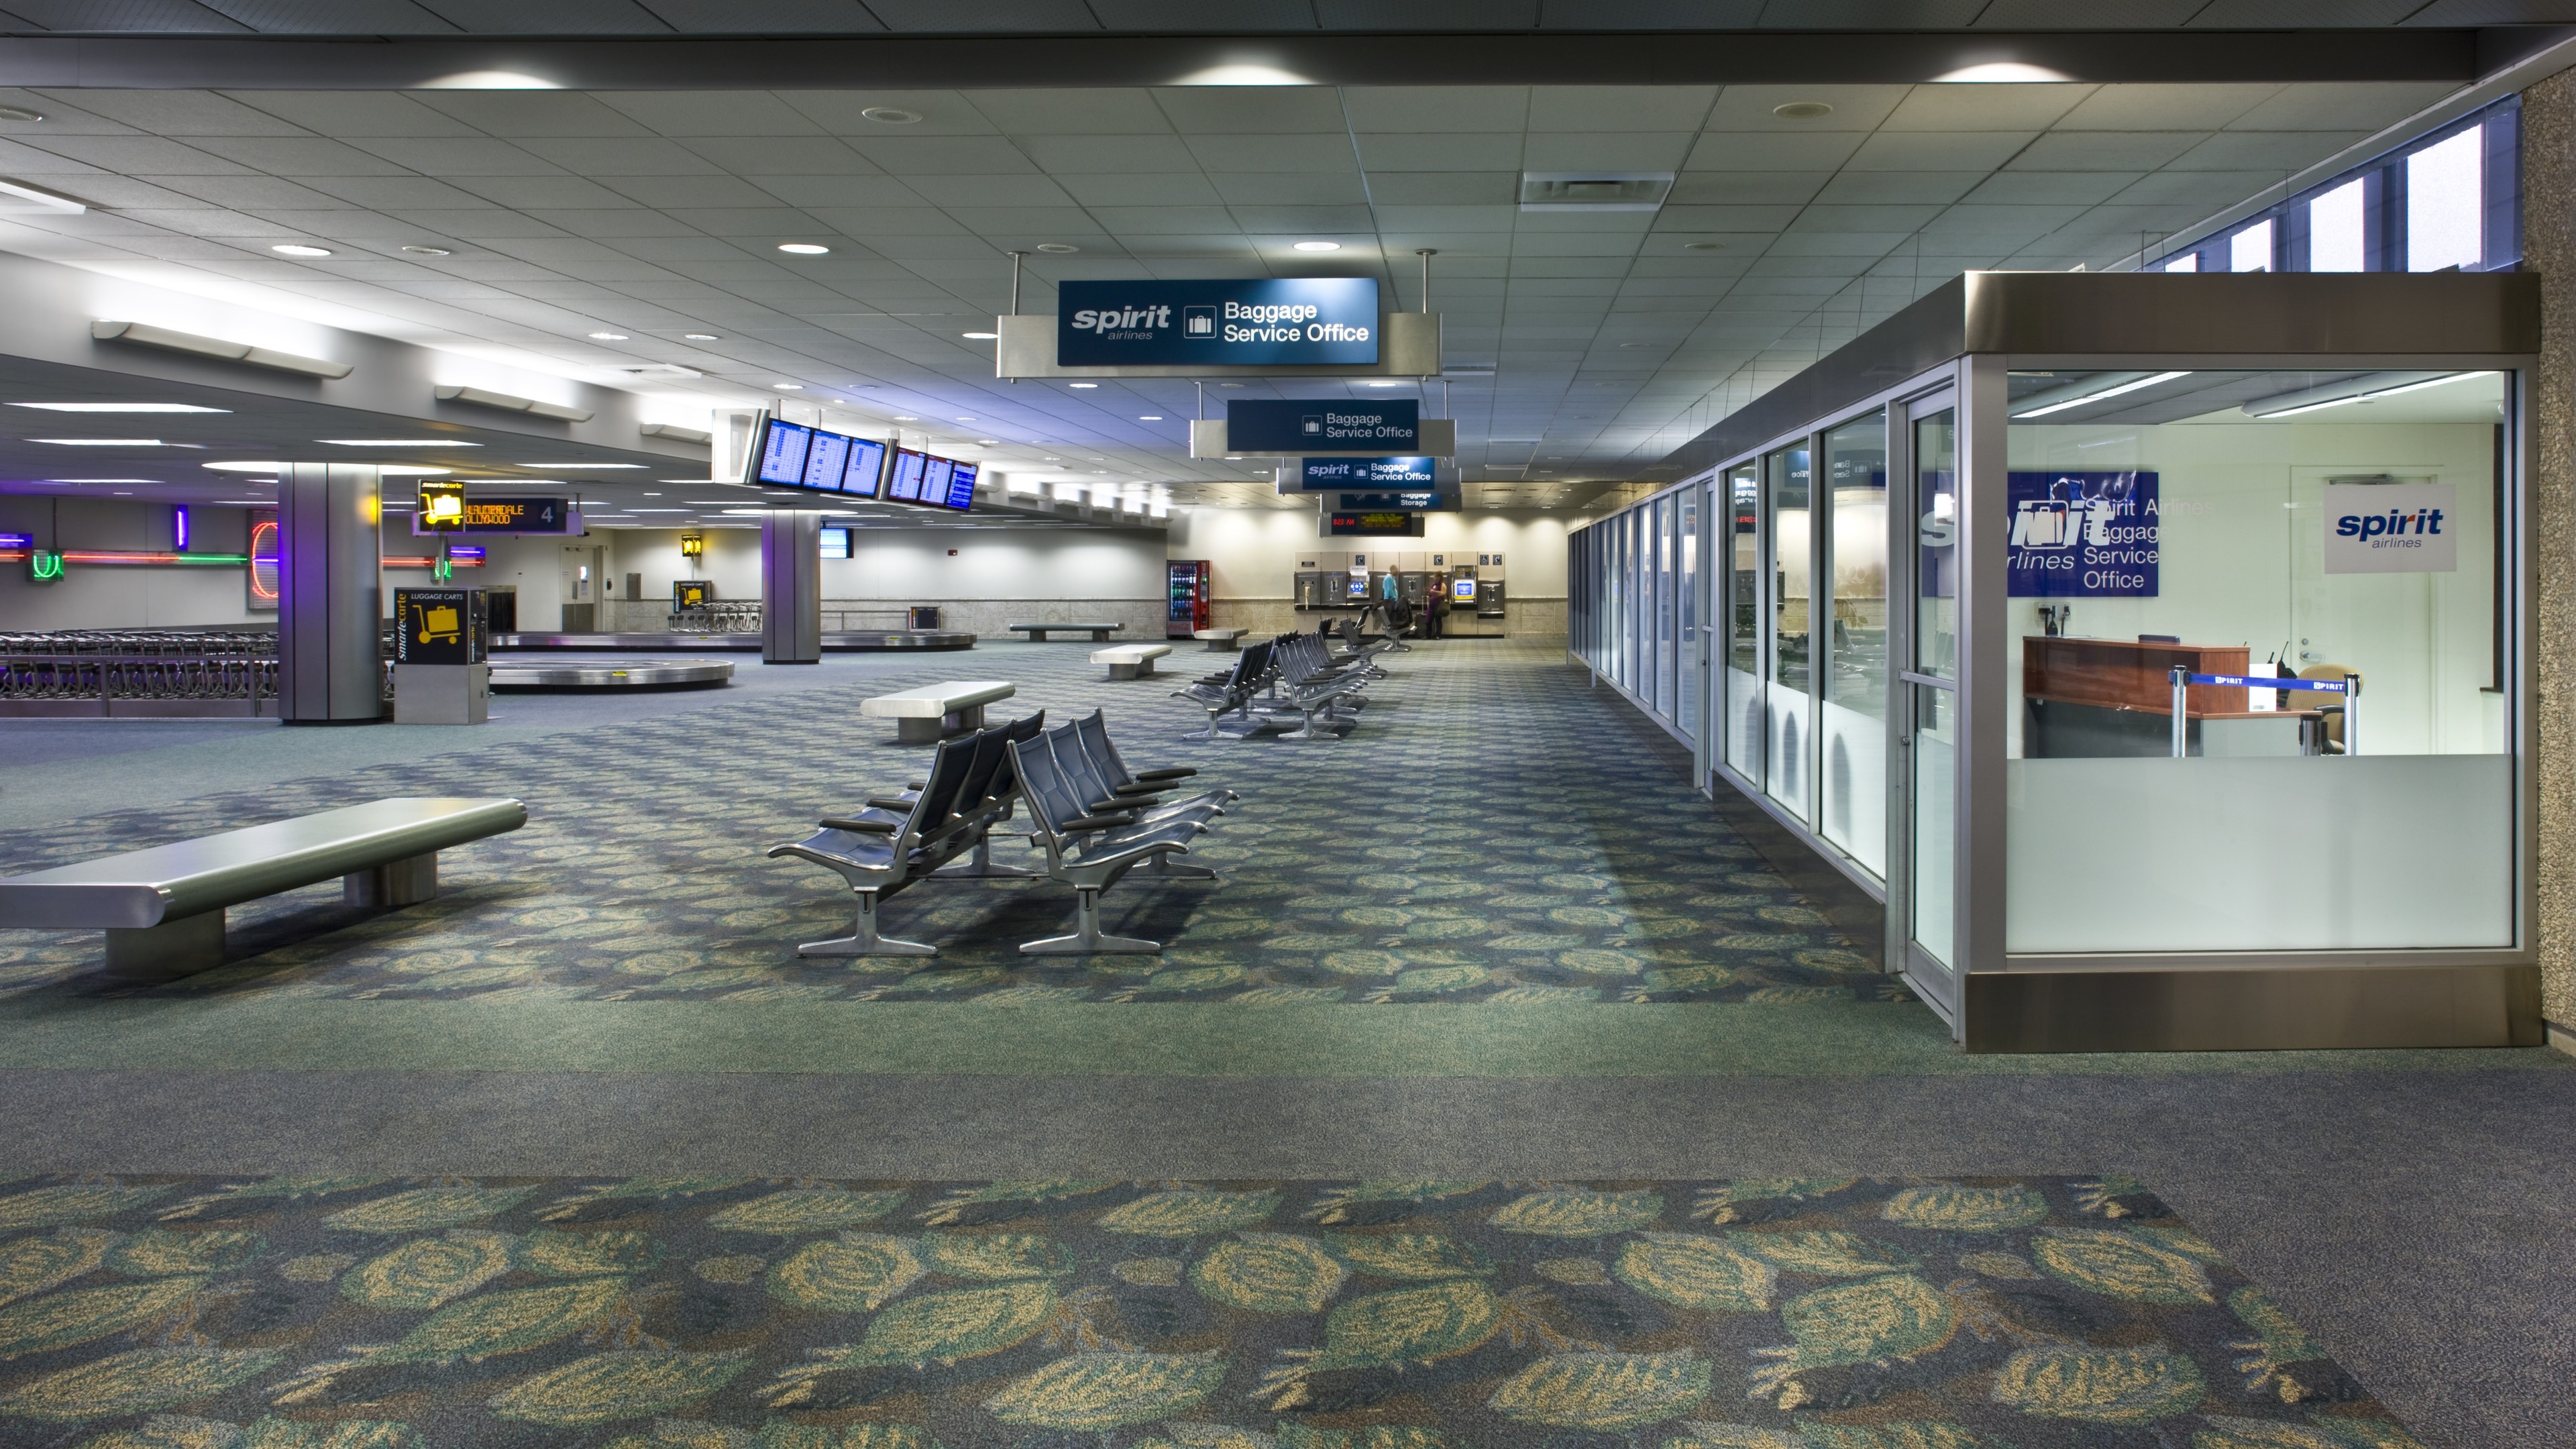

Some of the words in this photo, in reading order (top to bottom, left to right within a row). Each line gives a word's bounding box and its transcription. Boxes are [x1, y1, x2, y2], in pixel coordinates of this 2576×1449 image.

[1225, 302, 1317, 322] Baggage
[1071, 305, 1171, 334] spirit
[1108, 330, 1153, 341] airlines
[1224, 325, 1301, 342] Service
[1307, 323, 1369, 342] Office
[1326, 413, 1382, 427] Baggage
[1326, 427, 1373, 437] Service
[1376, 426, 1413, 437] Office
[1308, 464, 1349, 476] spirit
[1371, 464, 1410, 472] Baggage
[1371, 473, 1403, 481] Service
[1405, 473, 1431, 481] Office
[1401, 499, 1428, 507] Storage
[541, 506, 553, 523] 4
[2336, 508, 2444, 542] spirit
[2371, 537, 2422, 549] airlines
[2084, 547, 2159, 565] Service
[2084, 571, 2145, 589] Office
[397, 593, 407, 661] smartecarte
[2214, 676, 2243, 685] SPIRIT
[2313, 682, 2345, 691] SPIRIT
